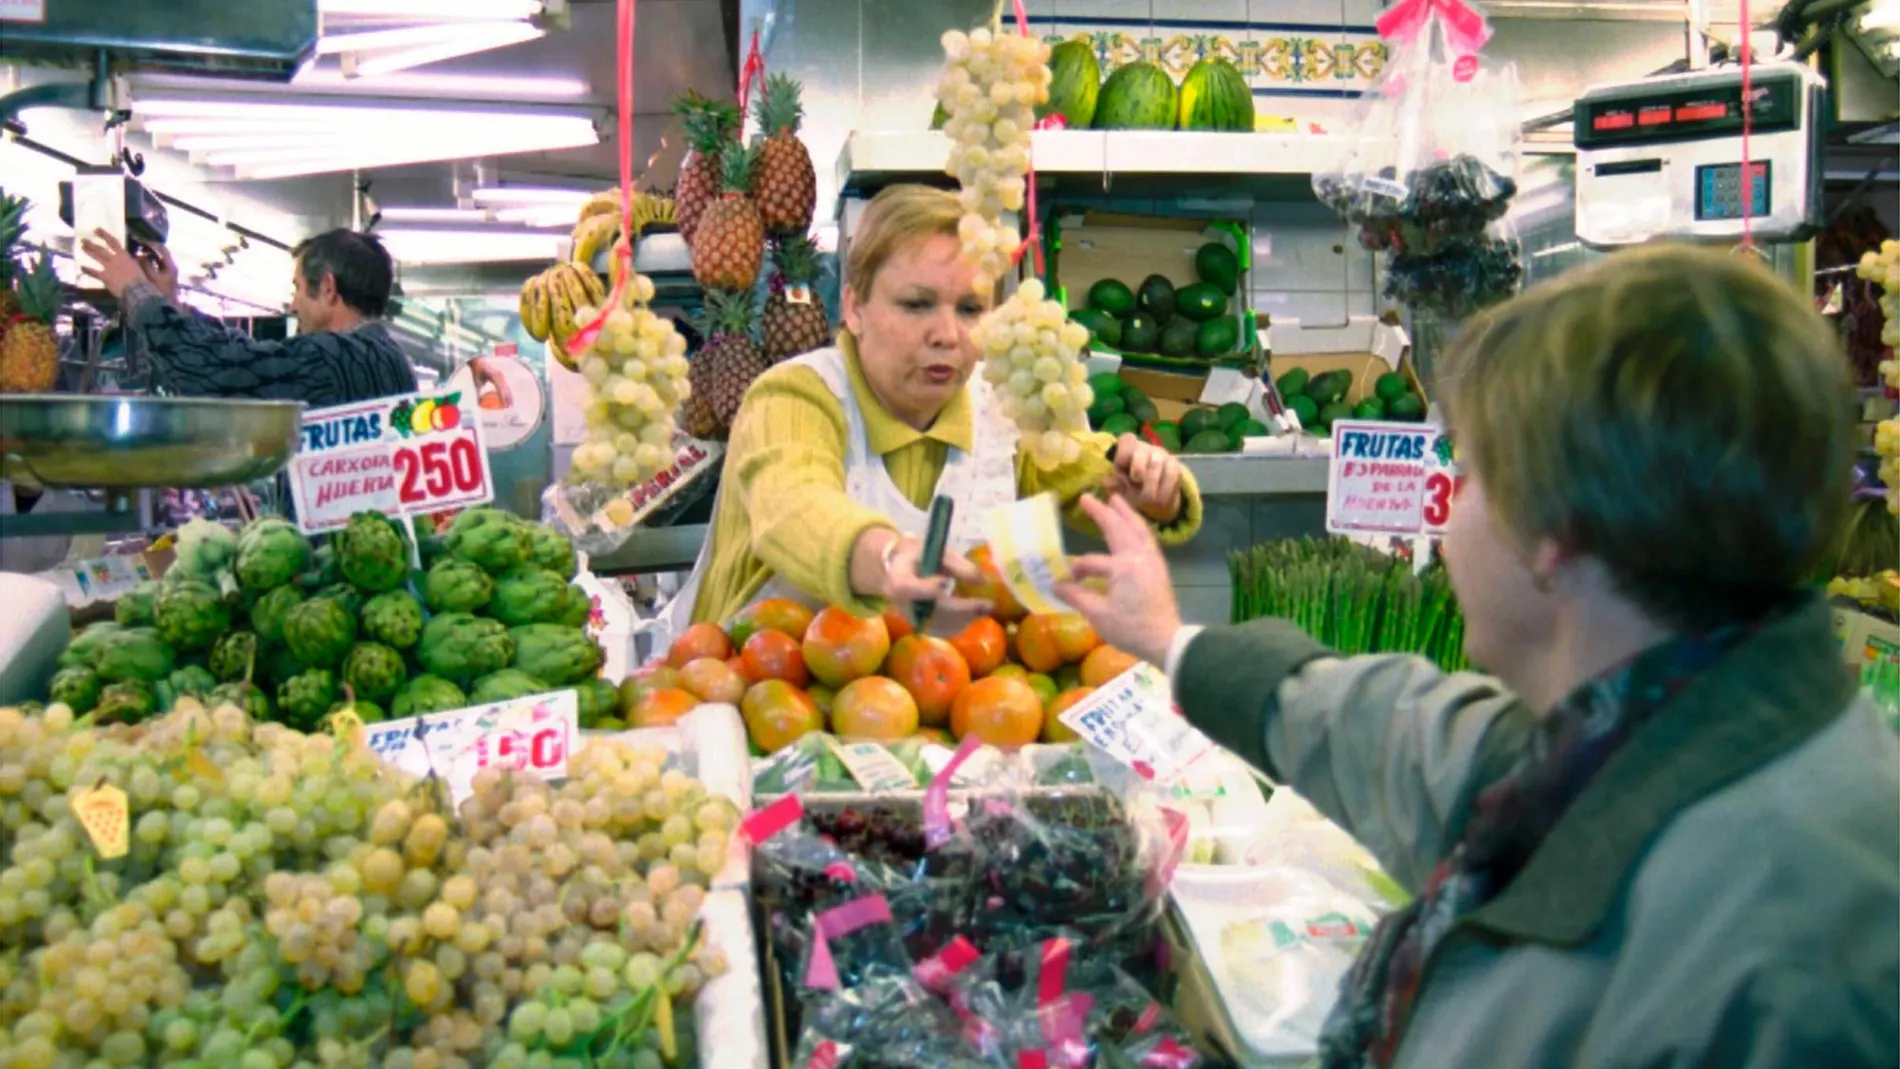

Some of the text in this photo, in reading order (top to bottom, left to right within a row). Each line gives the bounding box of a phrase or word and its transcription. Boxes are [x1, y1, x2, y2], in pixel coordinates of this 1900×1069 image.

[300, 412, 382, 453] FRUTAS
[1341, 431, 1426, 459] FRUTAS
[393, 437, 483, 503] 250
[1424, 471, 1464, 527] 3
[474, 728, 563, 771] 150
